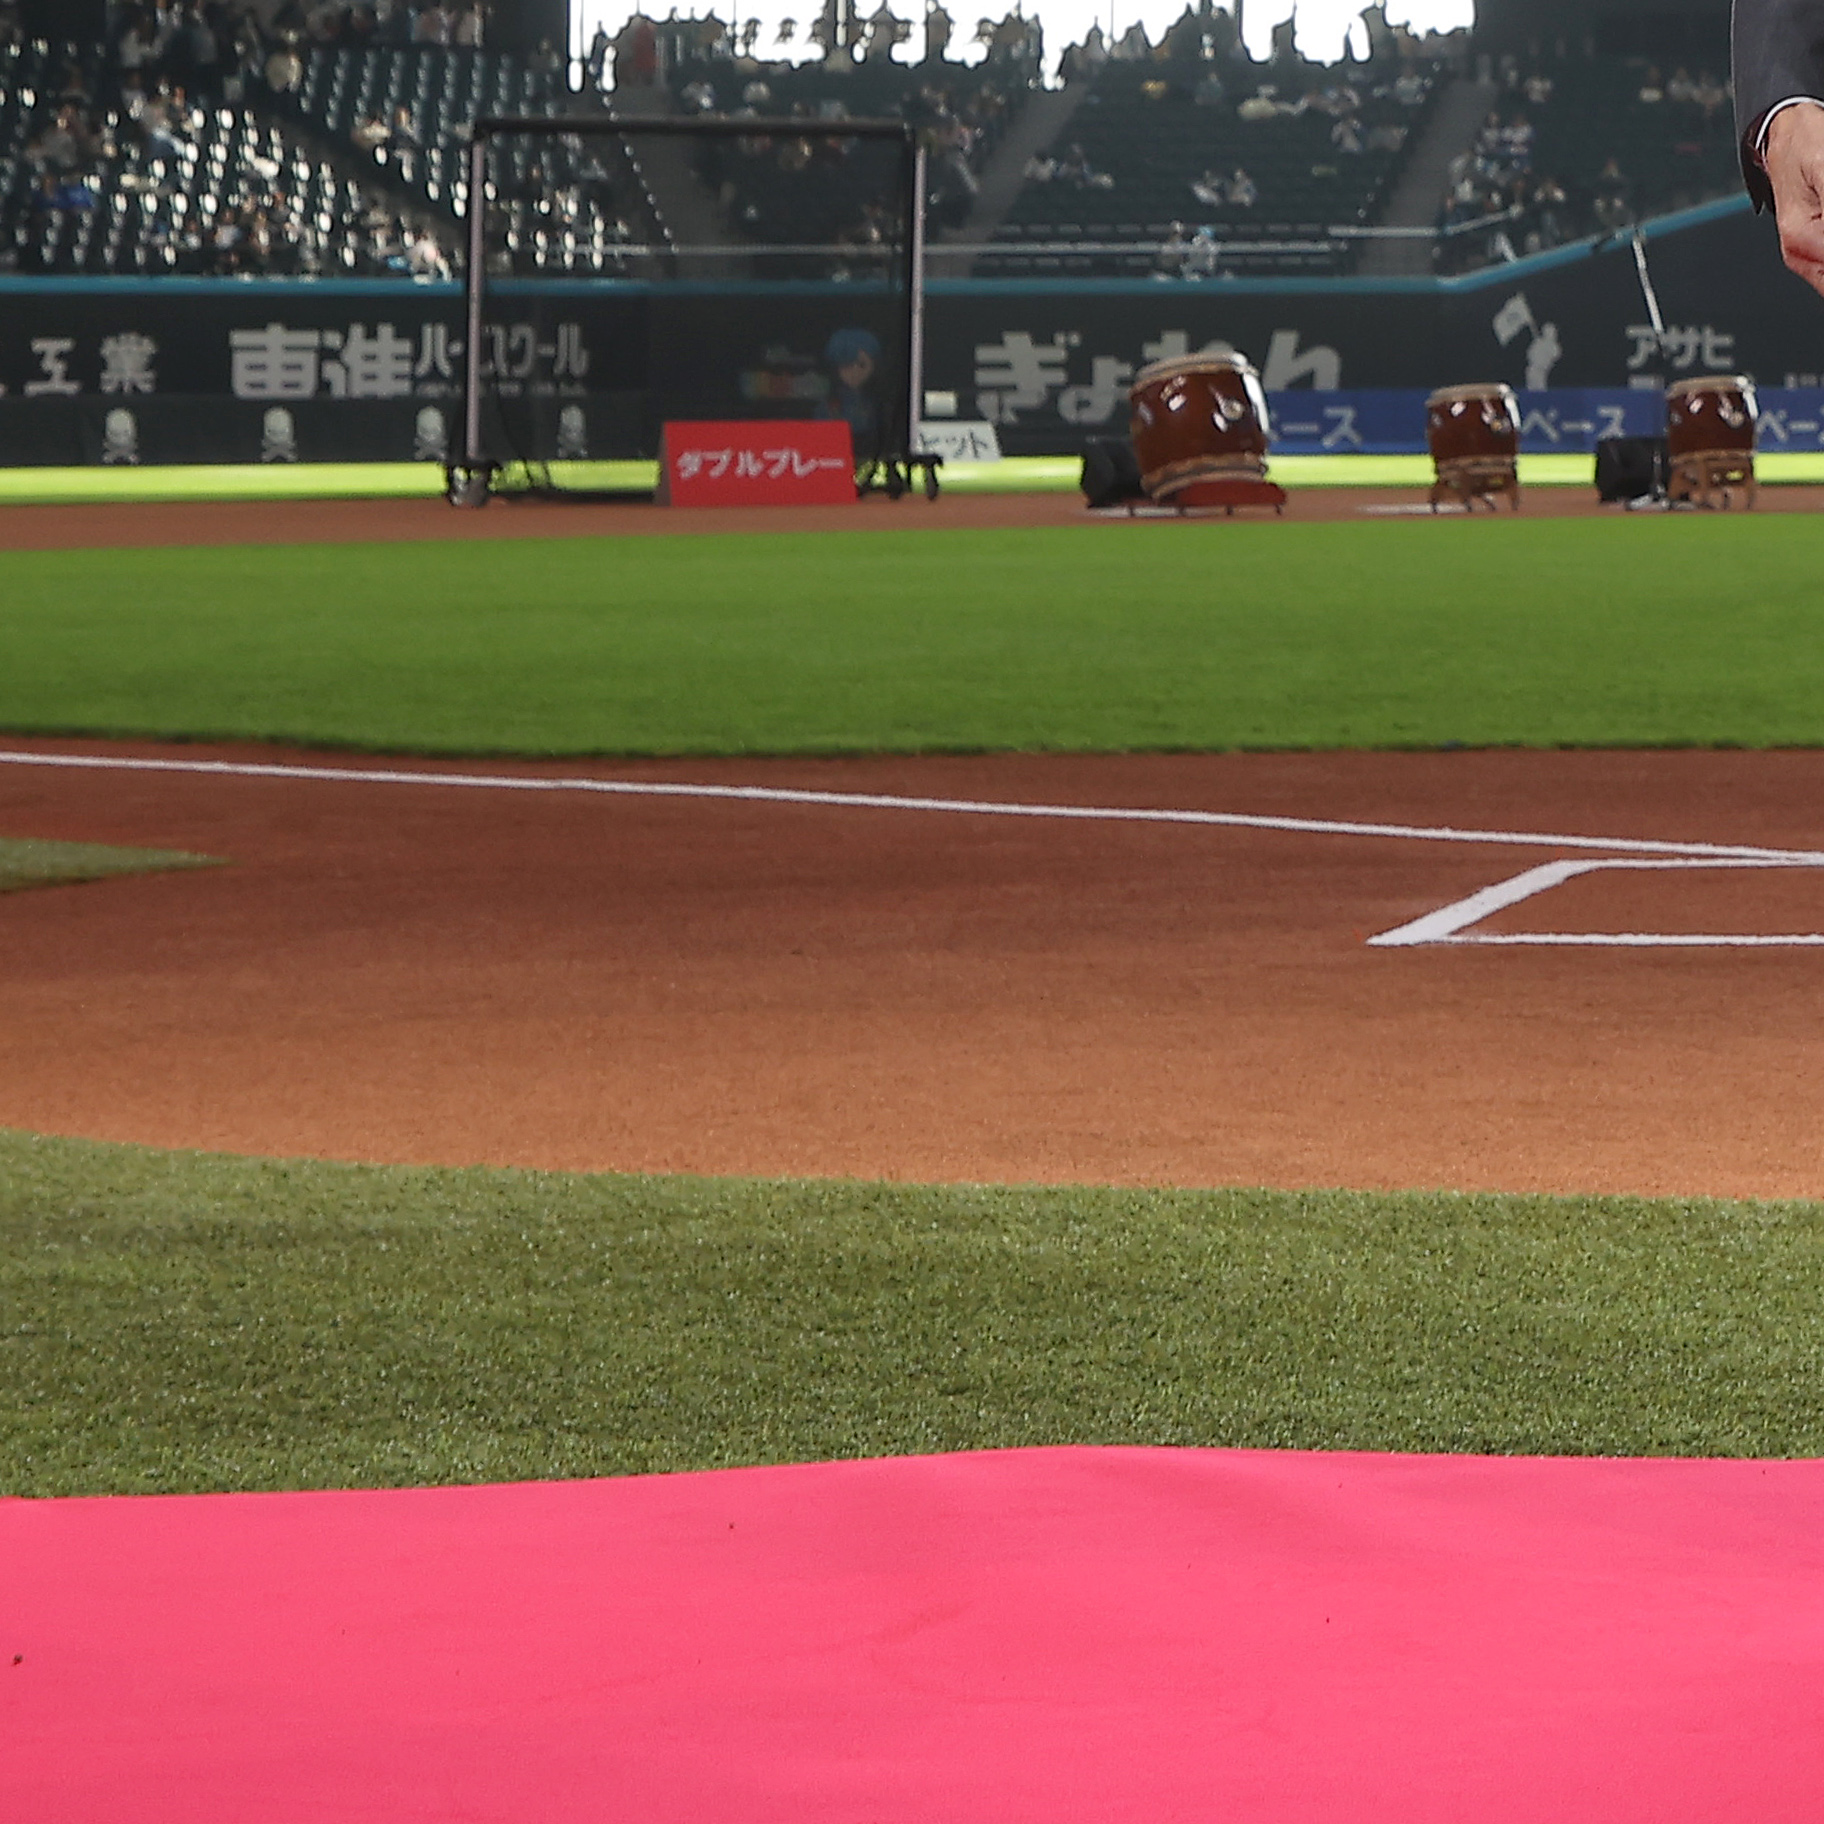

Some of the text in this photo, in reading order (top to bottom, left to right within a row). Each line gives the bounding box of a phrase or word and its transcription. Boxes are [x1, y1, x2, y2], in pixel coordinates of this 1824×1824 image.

[0, 332, 156, 394] 工業
[676, 447, 845, 481] ダブルプレー
